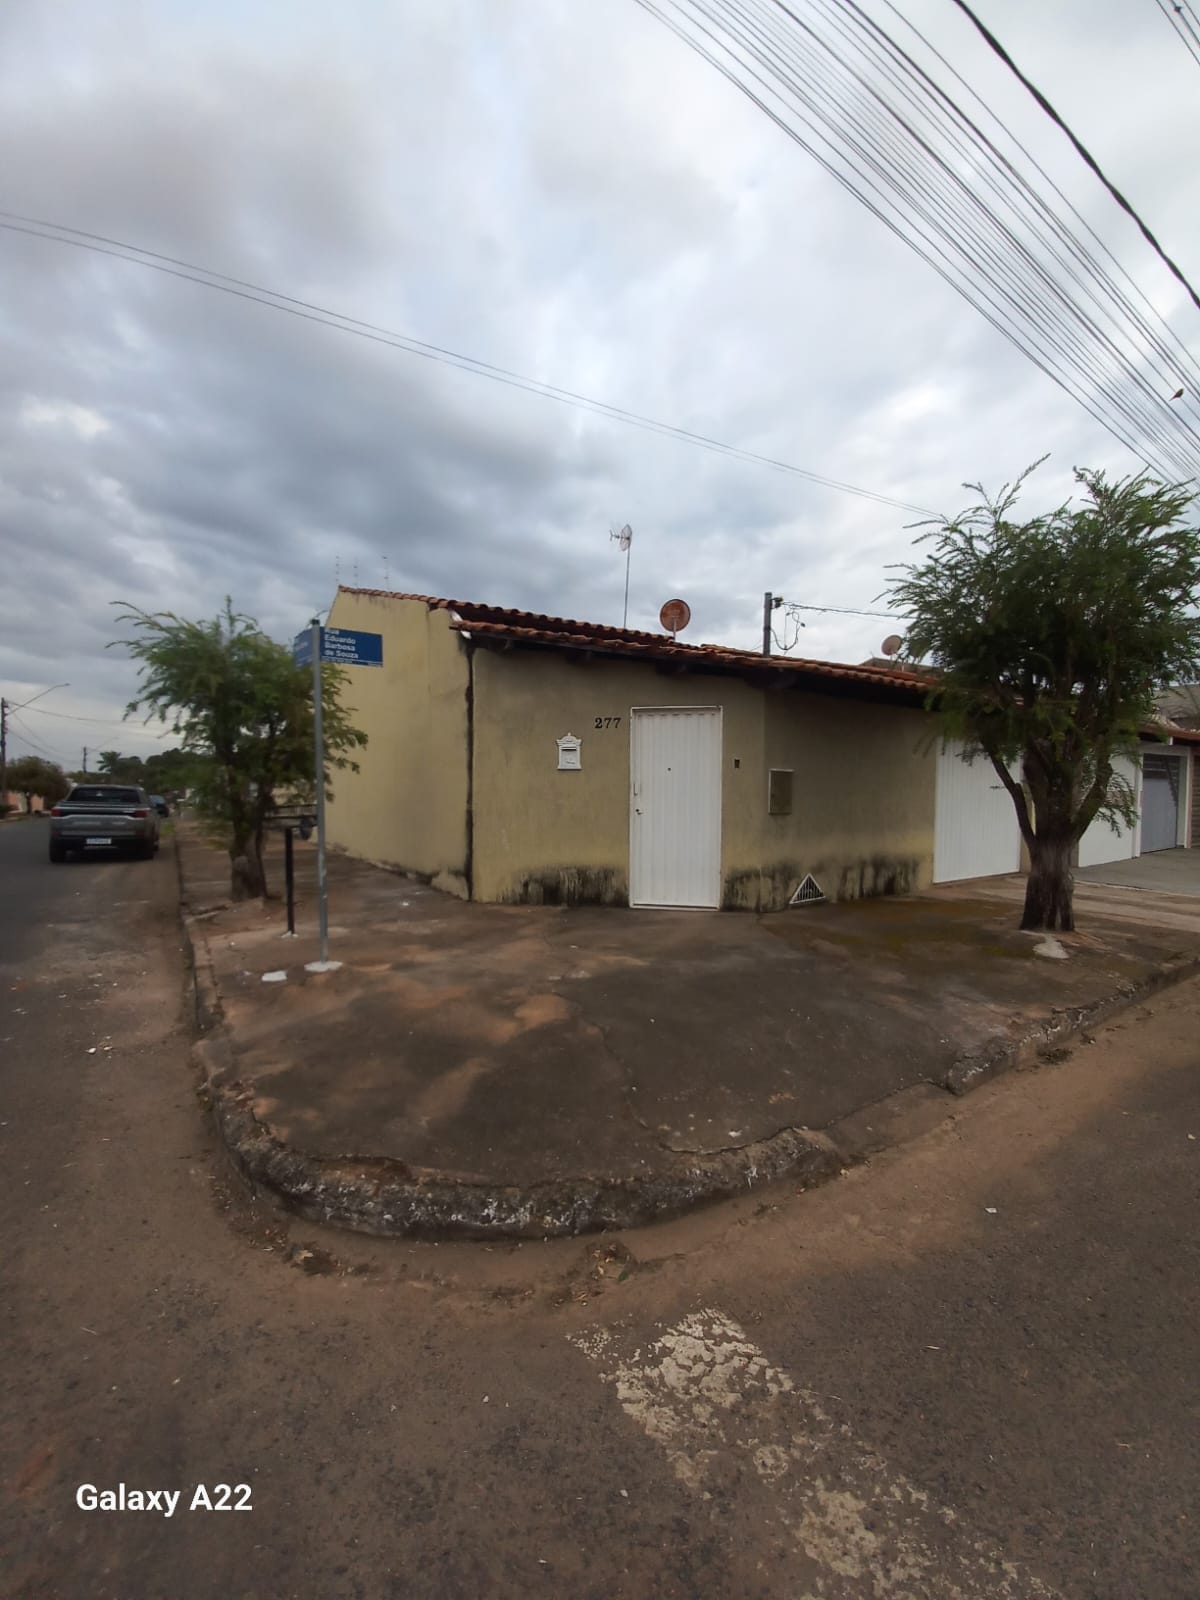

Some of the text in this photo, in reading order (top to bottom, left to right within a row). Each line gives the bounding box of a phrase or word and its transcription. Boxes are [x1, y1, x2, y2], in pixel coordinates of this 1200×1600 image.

[324, 634, 356, 645] Eduardo
[324, 641, 356, 651] Barbosa
[335, 650, 359, 659] Souza
[594, 717, 622, 729] 277
